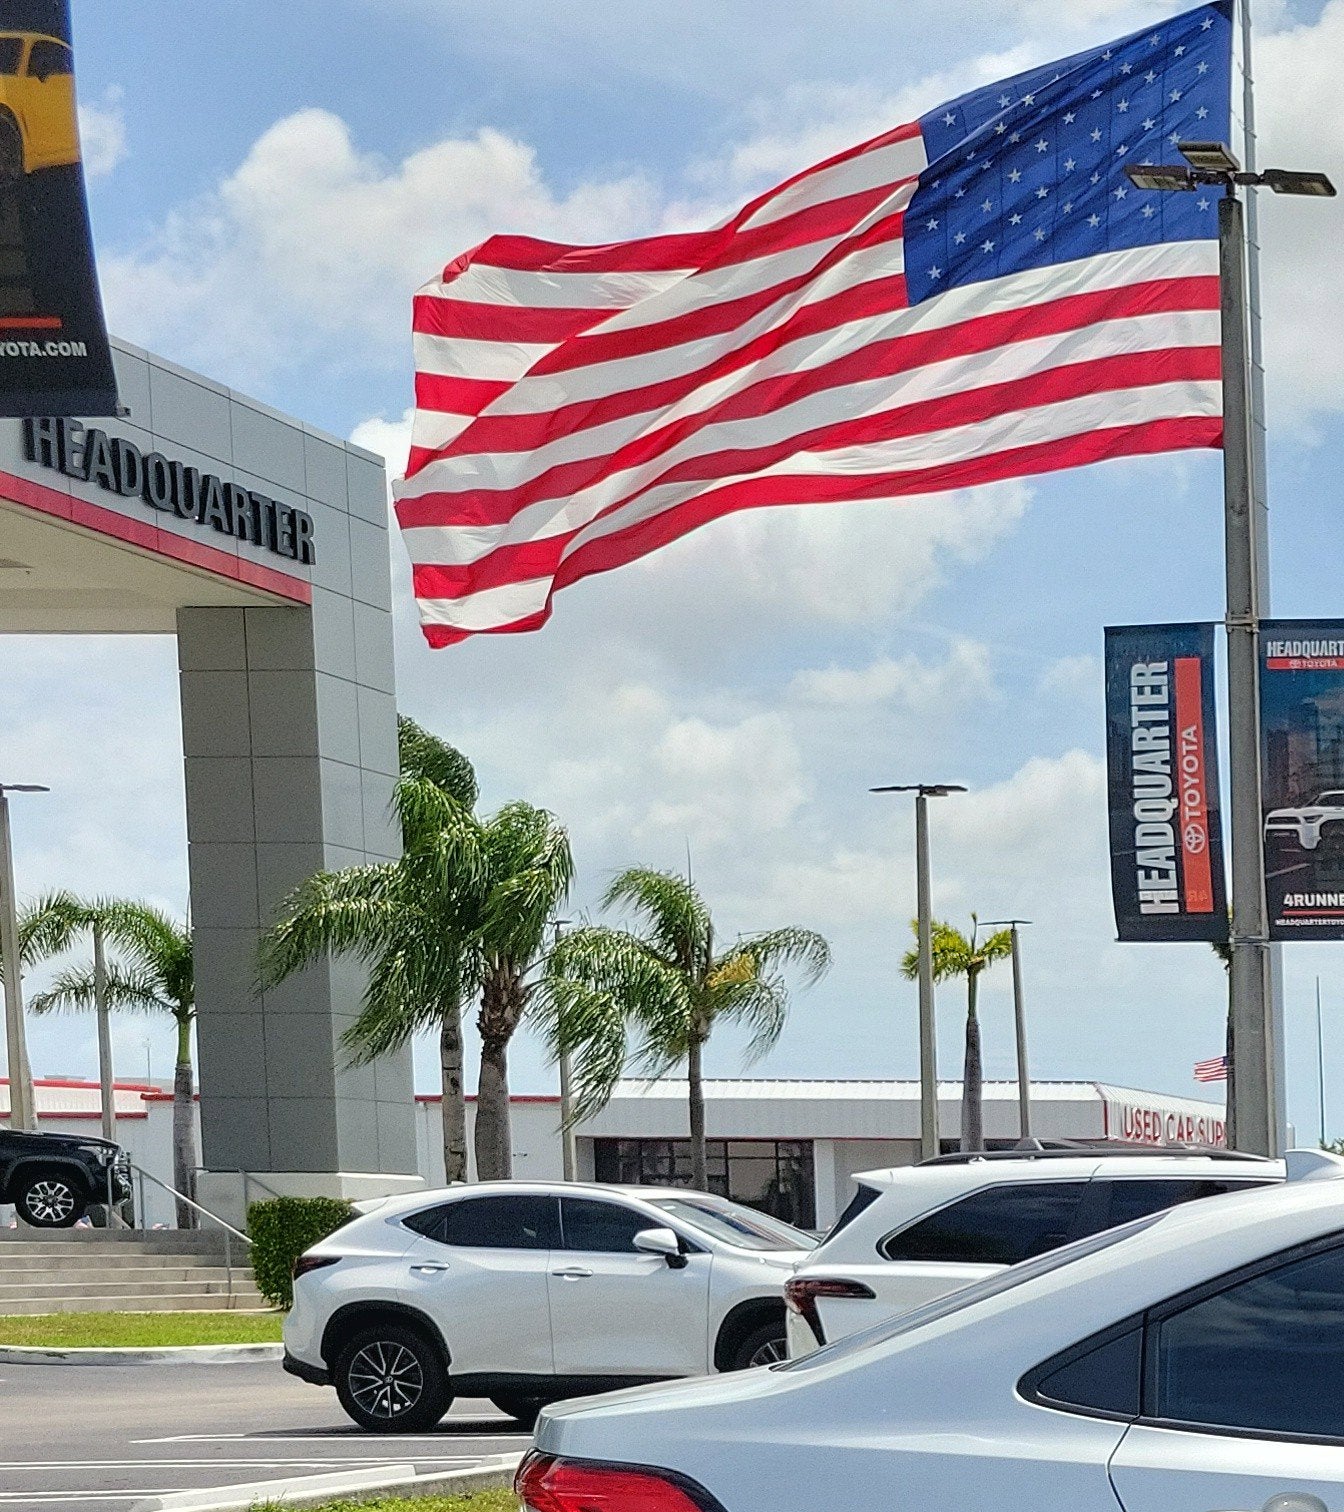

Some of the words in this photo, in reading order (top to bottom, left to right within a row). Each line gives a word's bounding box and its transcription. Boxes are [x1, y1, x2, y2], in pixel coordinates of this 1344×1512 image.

[22, 417, 316, 565] HEADQUARTER
[1302, 659, 1338, 668] TOYOTA
[1130, 660, 1180, 914] HEADQUARTER
[1181, 725, 1207, 821] TOYOTA
[1124, 1105, 1162, 1141] USED
[1167, 1113, 1196, 1142] CAR
[1198, 1117, 1228, 1146] SUP
